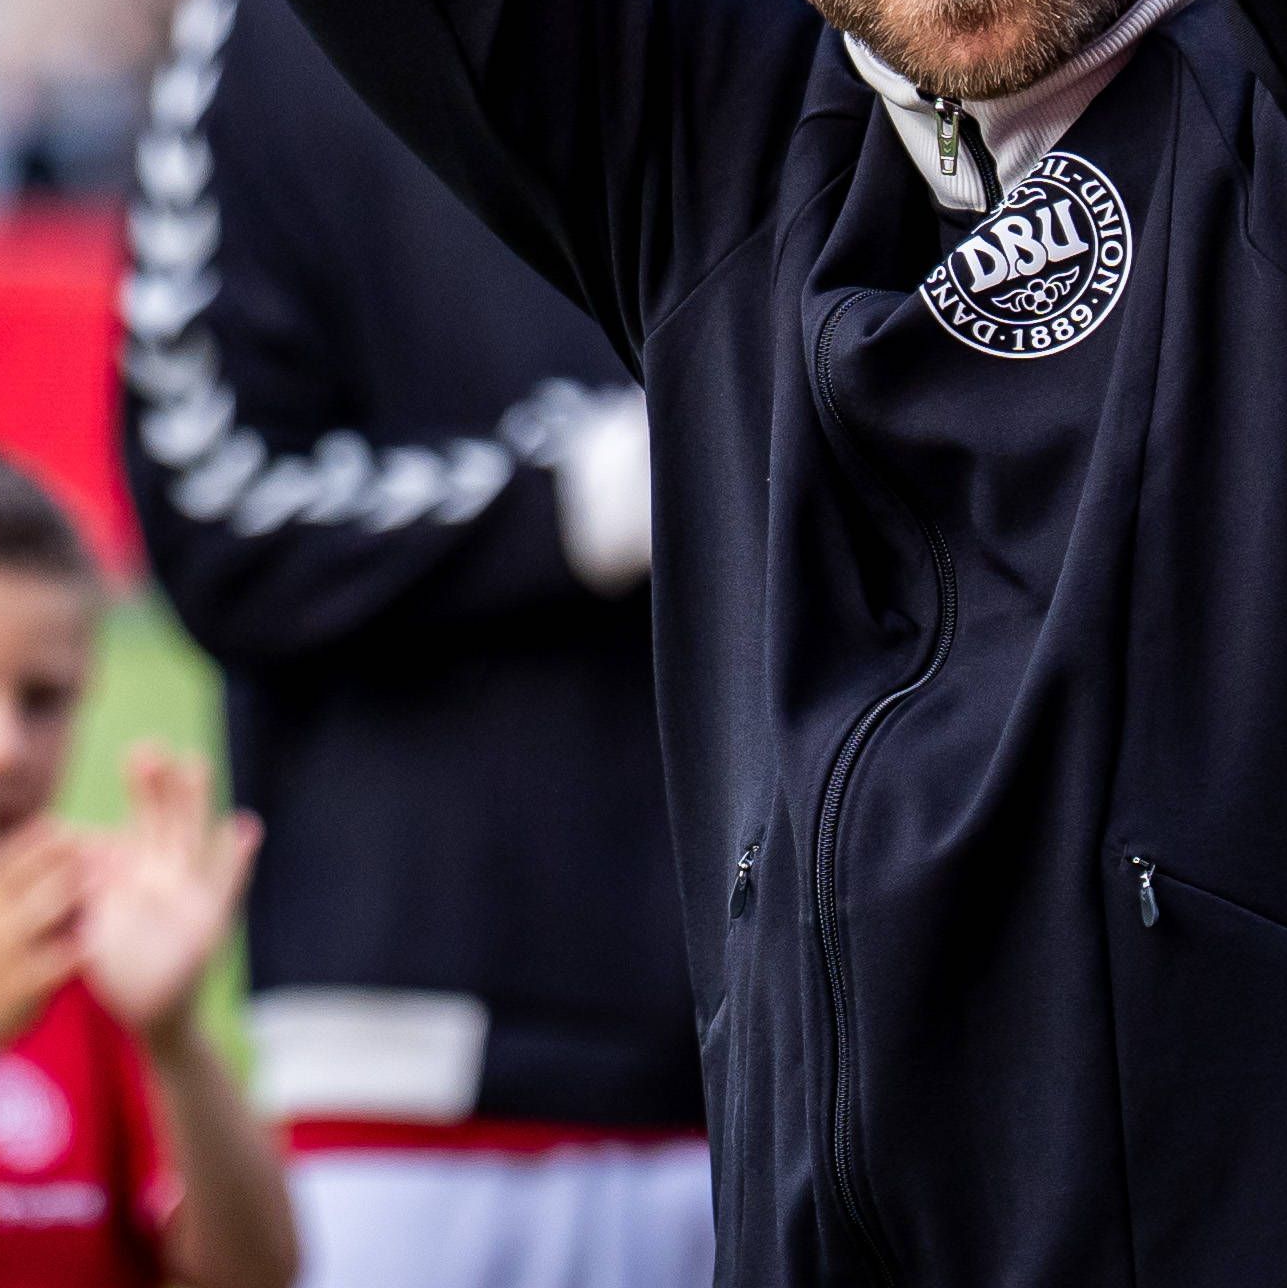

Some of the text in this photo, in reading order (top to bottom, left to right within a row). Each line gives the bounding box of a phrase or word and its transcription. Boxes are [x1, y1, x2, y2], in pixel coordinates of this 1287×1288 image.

[957, 199, 1089, 293] DBU
[927, 264, 999, 344] DANS
[1011, 304, 1093, 351] 1889
